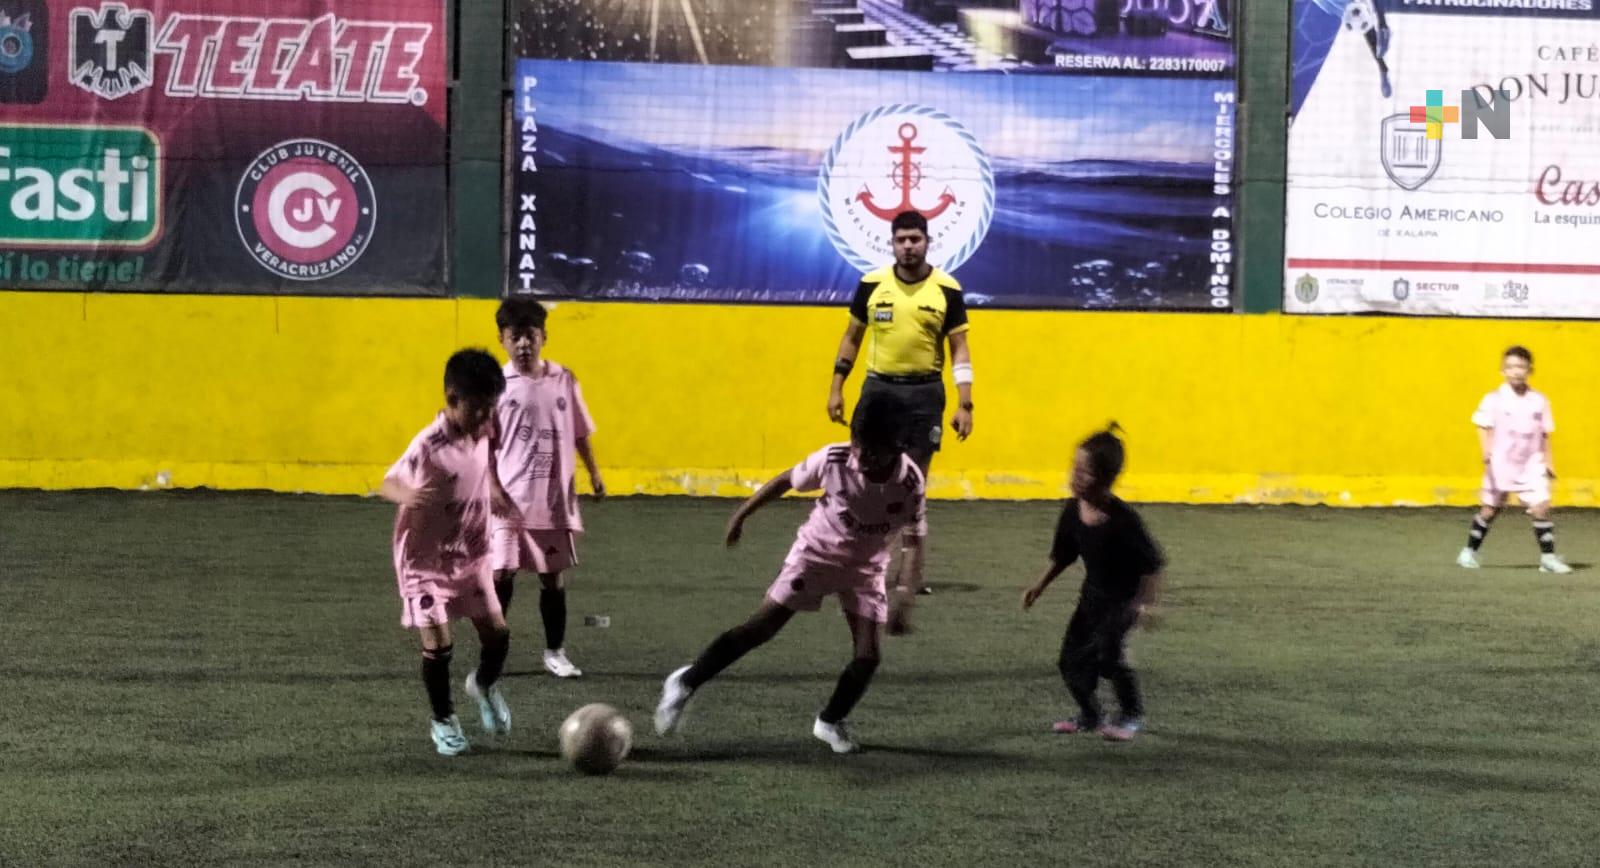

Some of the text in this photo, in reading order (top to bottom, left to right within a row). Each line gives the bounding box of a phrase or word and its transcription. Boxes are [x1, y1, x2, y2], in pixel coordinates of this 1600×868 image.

[1055, 54, 1226, 72] RESERVA AL: 2283170007
[1537, 44, 1599, 62] CAFÉ
[1471, 73, 1600, 110] DON JU
[250, 144, 361, 183] CLUB JUVENIL
[519, 76, 538, 289] PLAZA XANAT
[1210, 92, 1235, 308] MIERCOLES A DOMINGO
[1313, 203, 1505, 223] COLEGIO AMERICANO
[1534, 211, 1551, 224] La
[20, 254, 50, 281] lo
[58, 255, 145, 282] tiene!
[255, 242, 358, 276] VERACRUZANO
[1415, 282, 1460, 291] SECTUR
